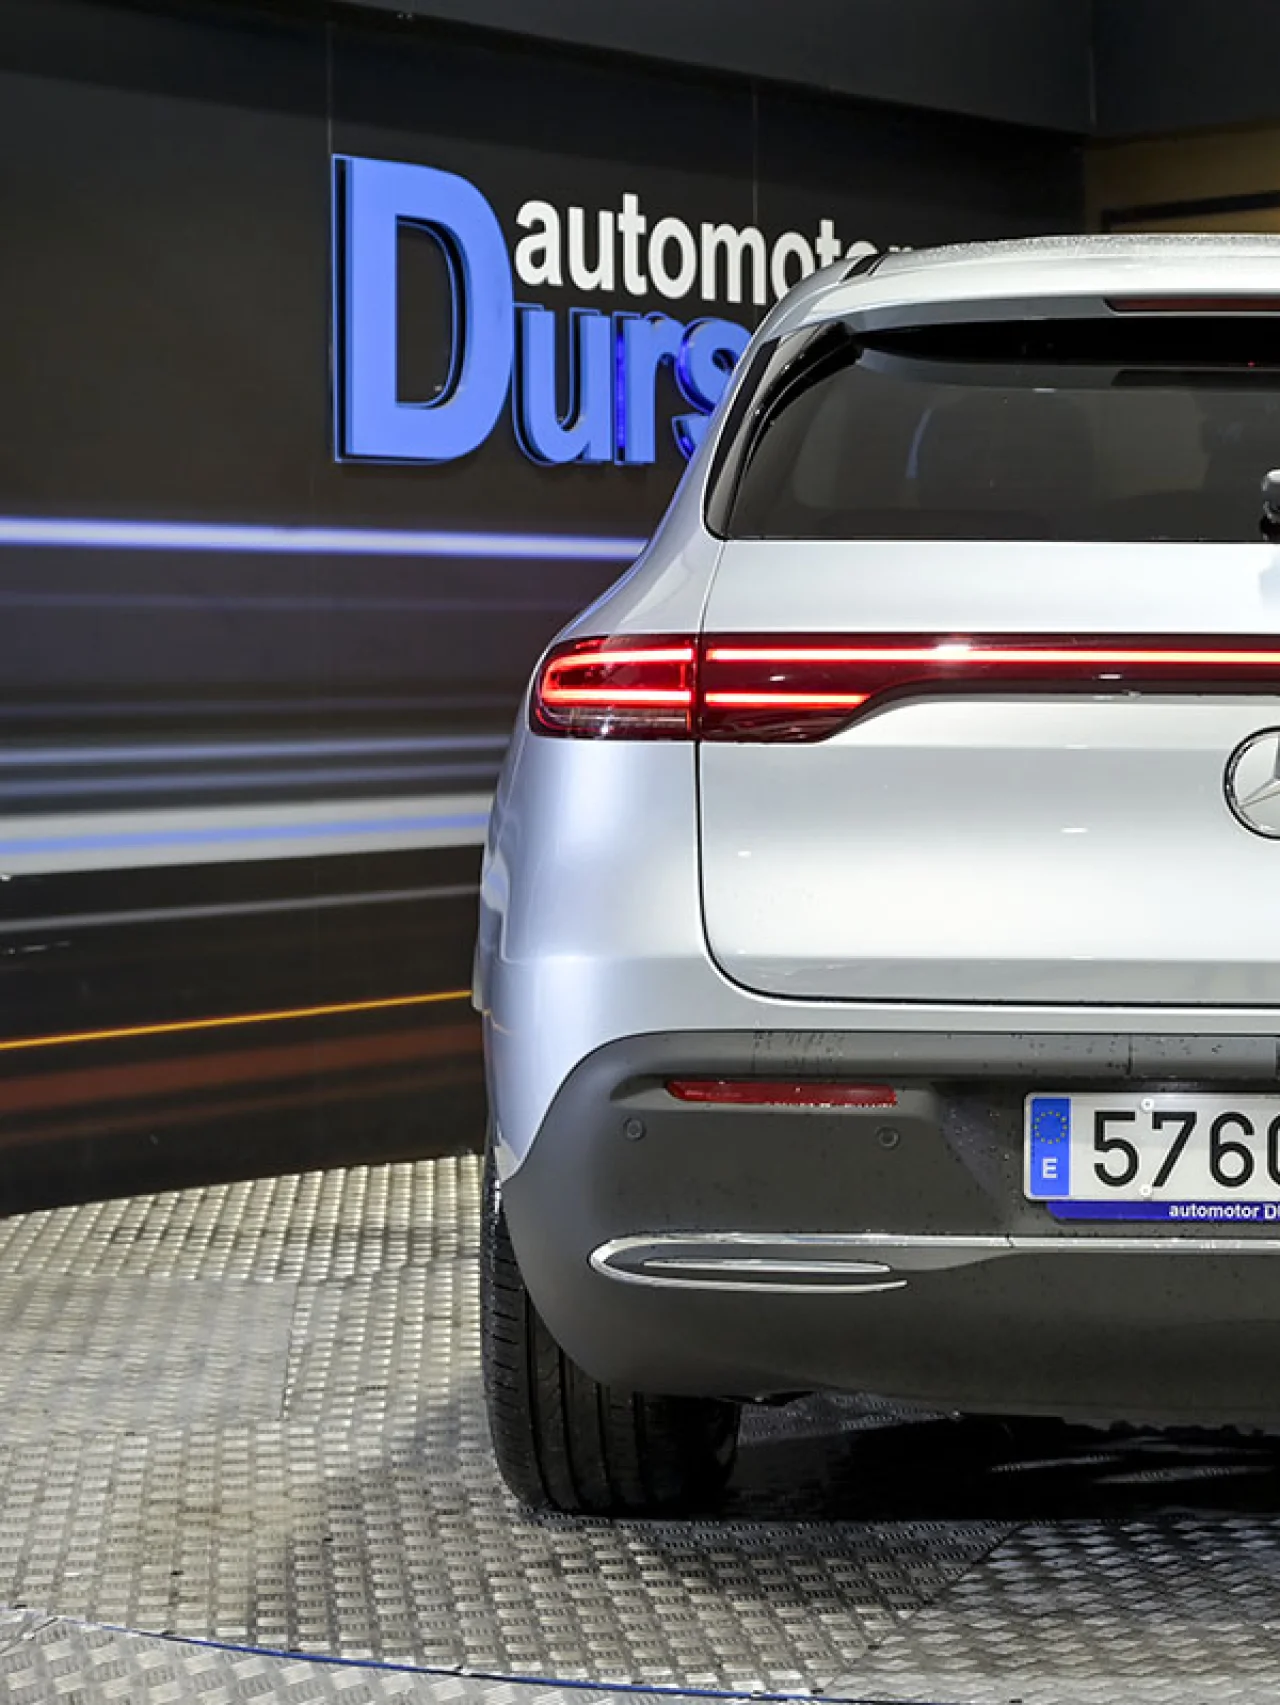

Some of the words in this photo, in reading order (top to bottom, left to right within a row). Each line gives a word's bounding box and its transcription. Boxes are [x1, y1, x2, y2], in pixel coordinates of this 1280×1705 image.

[514, 193, 913, 305] automot
[1042, 1157, 1058, 1179] E
[1168, 1203, 1260, 1218] automotor
